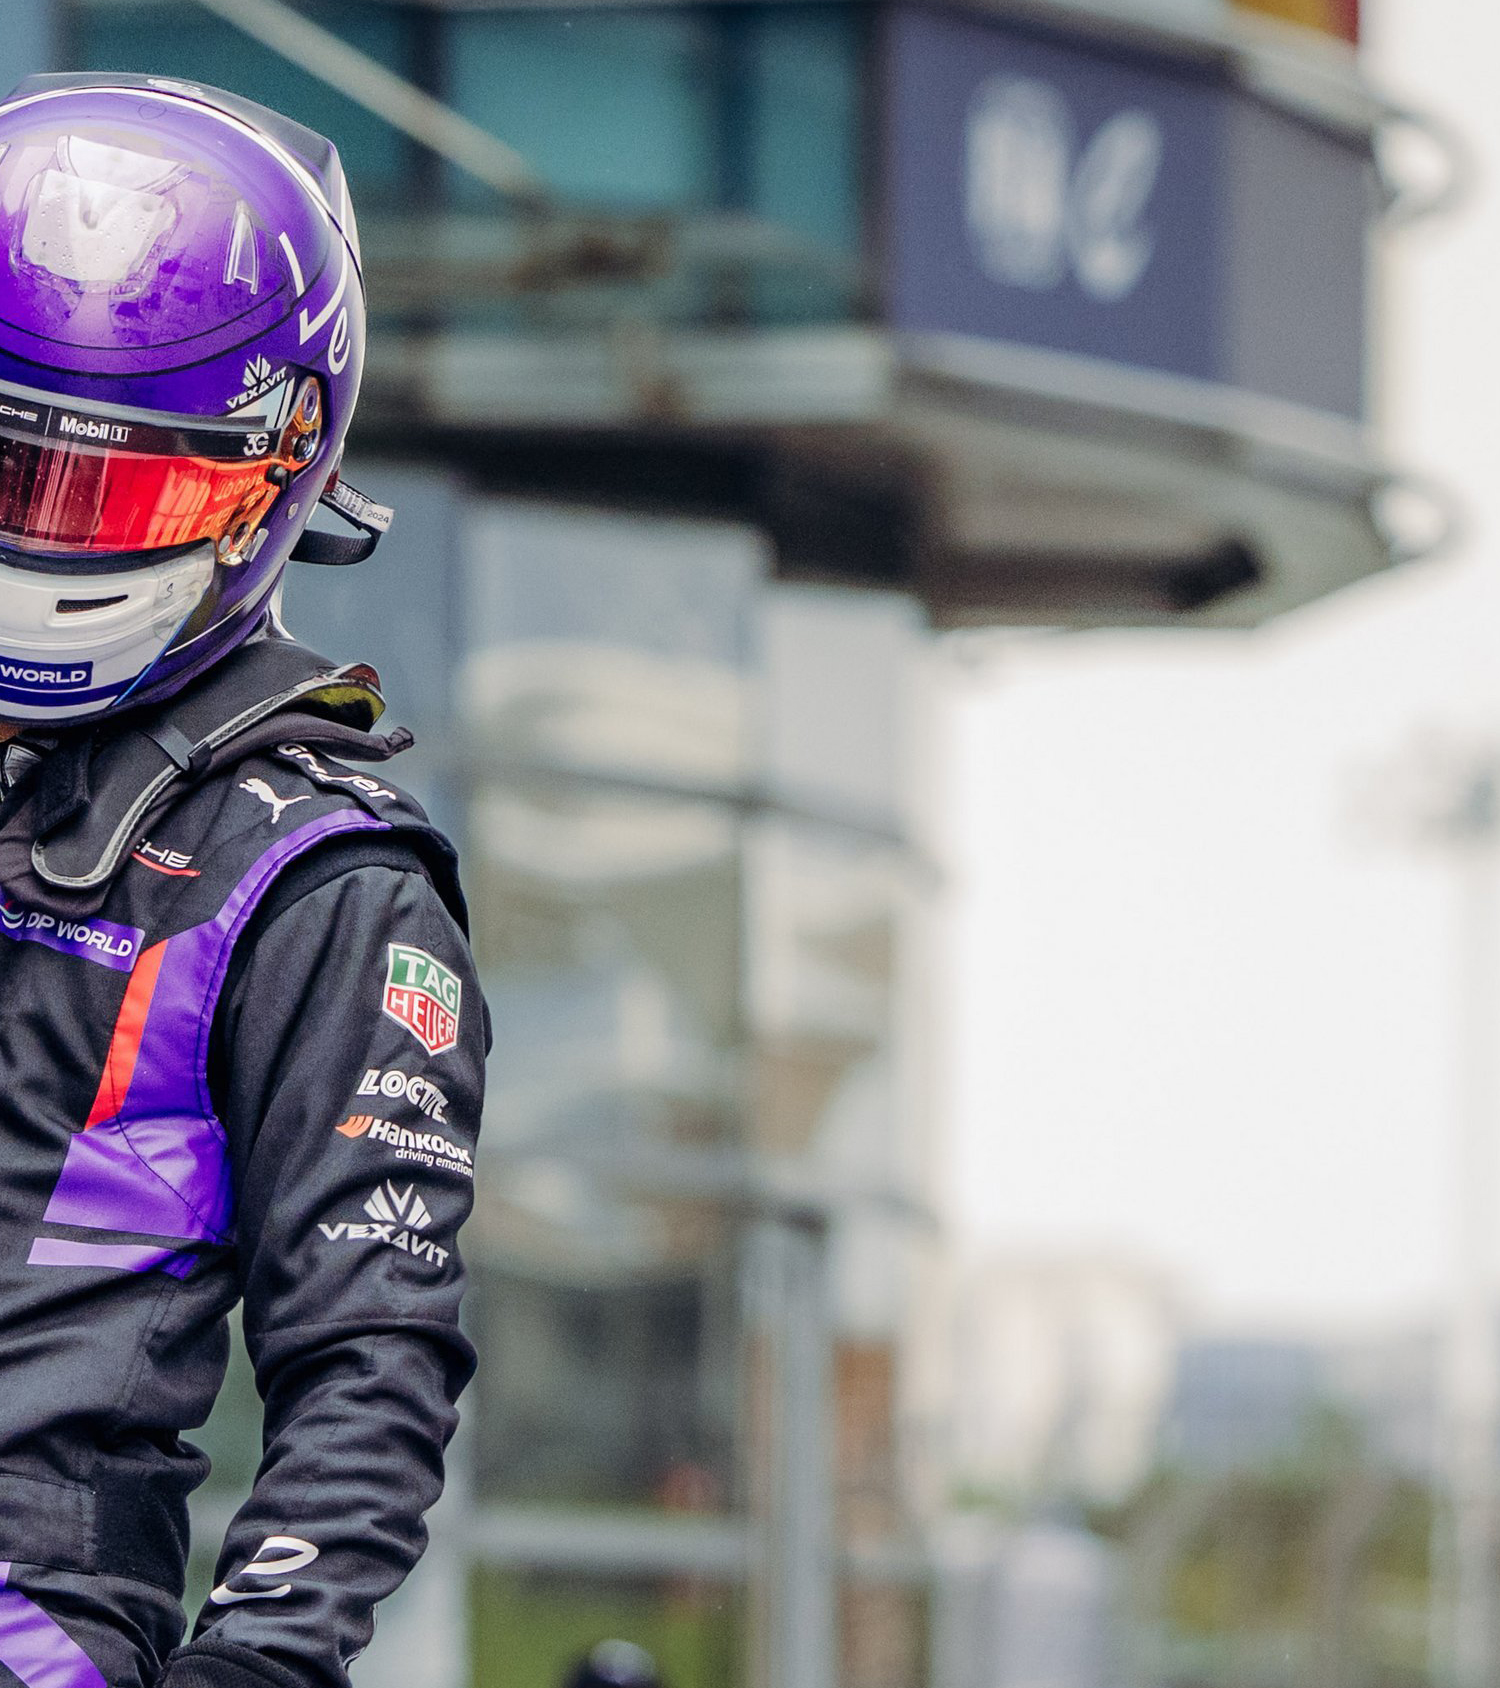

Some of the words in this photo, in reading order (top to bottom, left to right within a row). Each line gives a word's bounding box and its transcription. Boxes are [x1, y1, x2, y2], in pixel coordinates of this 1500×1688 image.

[225, 366, 288, 409] VEXAVIT
[59, 415, 110, 440] Mobil
[367, 510, 390, 523] 2024
[0, 663, 87, 684] WORLD
[26, 911, 56, 930] DP
[57, 919, 133, 958] WORLD
[397, 952, 457, 1010] TAG
[390, 990, 455, 1048] HEUER
[395, 1147, 435, 1167] driving
[435, 1155, 474, 1179] emotion
[317, 1222, 450, 1268] VEXAVIT
